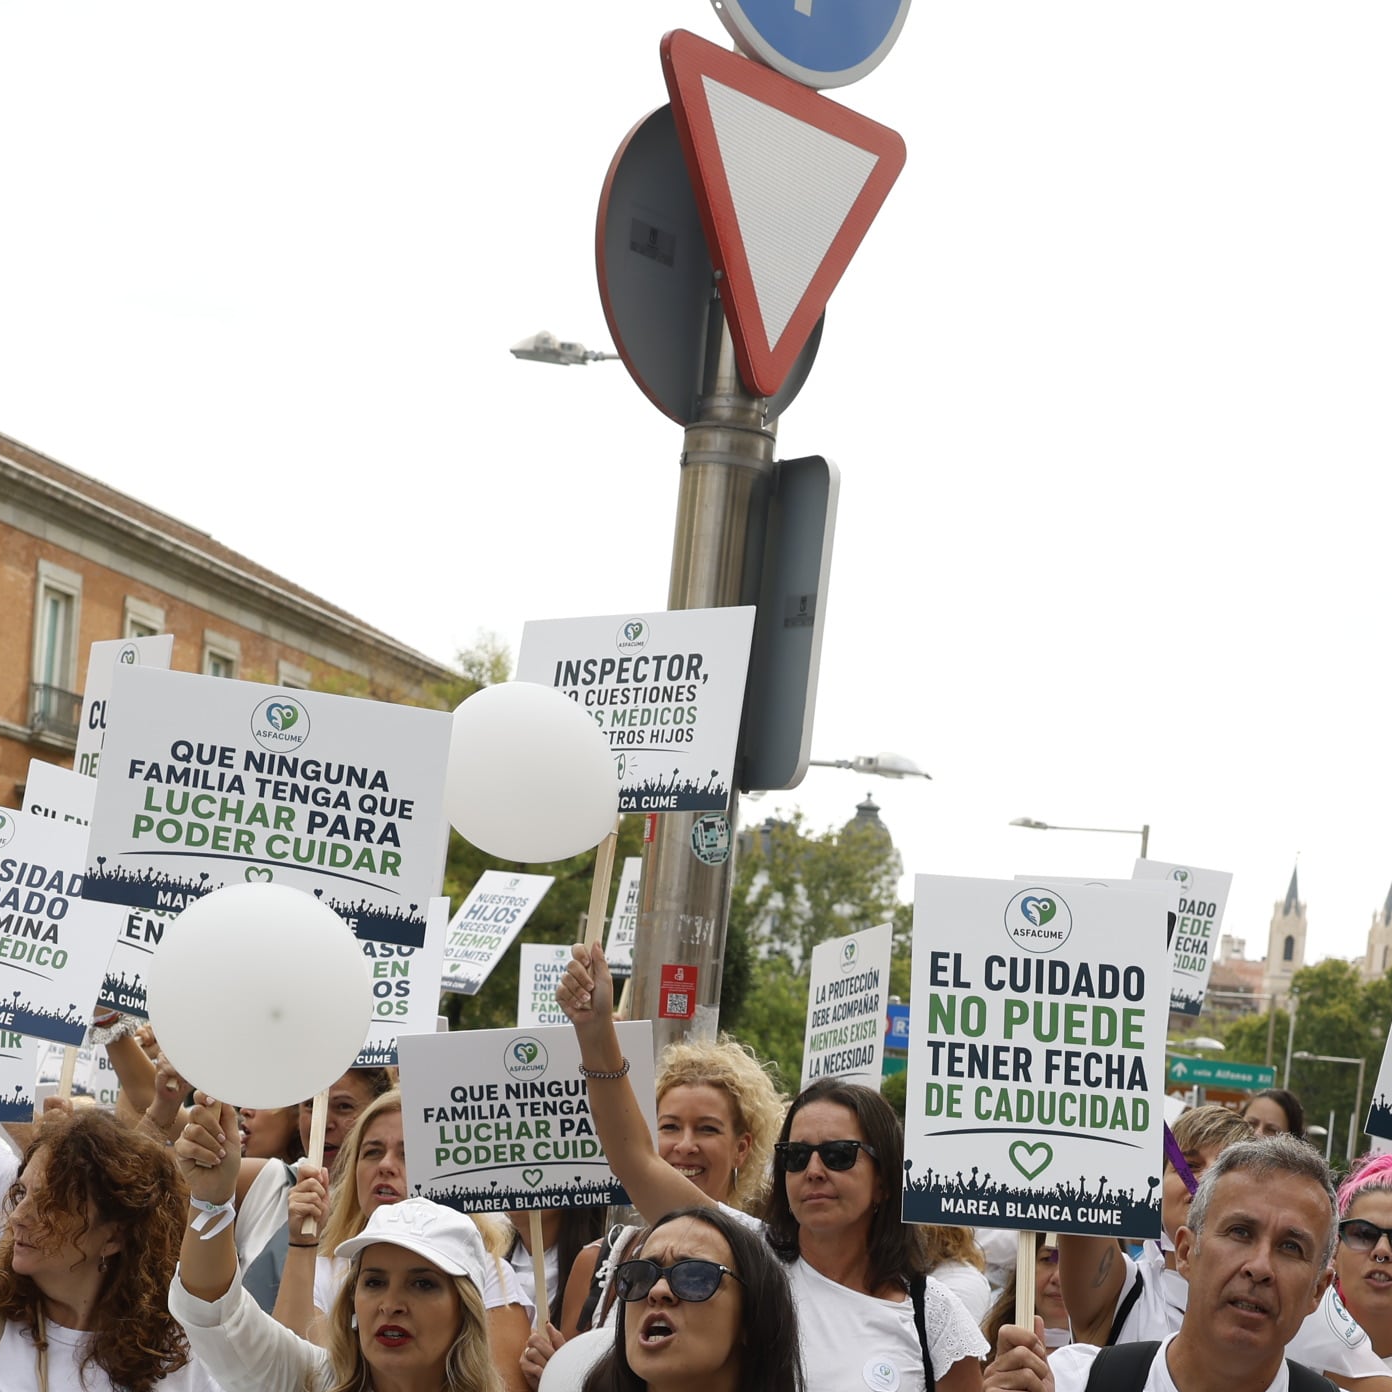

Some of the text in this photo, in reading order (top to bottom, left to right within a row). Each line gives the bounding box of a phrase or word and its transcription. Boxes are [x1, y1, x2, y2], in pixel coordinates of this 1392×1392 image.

[554, 653, 709, 687] INSPECTOR,
[585, 685, 697, 706] CUESTIONES
[611, 705, 697, 727] MÉDICOS
[256, 729, 303, 743] ASFACUME
[650, 728, 694, 744] HIJOS
[170, 740, 389, 792] QUE NINGUNA
[128, 760, 414, 820] FAMILIA TENGA QUE
[143, 787, 402, 848] LUCHAR PARA
[131, 814, 256, 855] PODER
[264, 834, 402, 877] CUIDAR
[475, 893, 529, 907] NUESTROS
[464, 904, 521, 924] HIJOS
[457, 921, 510, 935] NECESITAN
[1013, 929, 1063, 940] ASFACUME
[816, 967, 880, 1005] LA PROTECCIÓN
[929, 951, 1145, 1002] EL CUIDADO
[812, 994, 879, 1029] DEBE ACOMPAÑAR
[928, 993, 1145, 1050] NO PUEDE
[810, 1028, 848, 1053] MIENTRAS
[850, 1019, 877, 1043] EXISTA
[509, 1064, 544, 1072] ASFACUME
[809, 1044, 874, 1078] LA NECESIDAD
[927, 1040, 1148, 1092] TENER FECHA
[451, 1084, 498, 1103] QUE
[423, 1099, 589, 1123] FAMILIA TENGA
[925, 1082, 1150, 1132] DE CADUCIDAD
[439, 1120, 552, 1144] LUCHAR
[435, 1142, 525, 1167] PODER
[463, 1192, 611, 1212] MAREA BLANCA CUME
[941, 1197, 1122, 1225] MAREA BLANCA CUME
